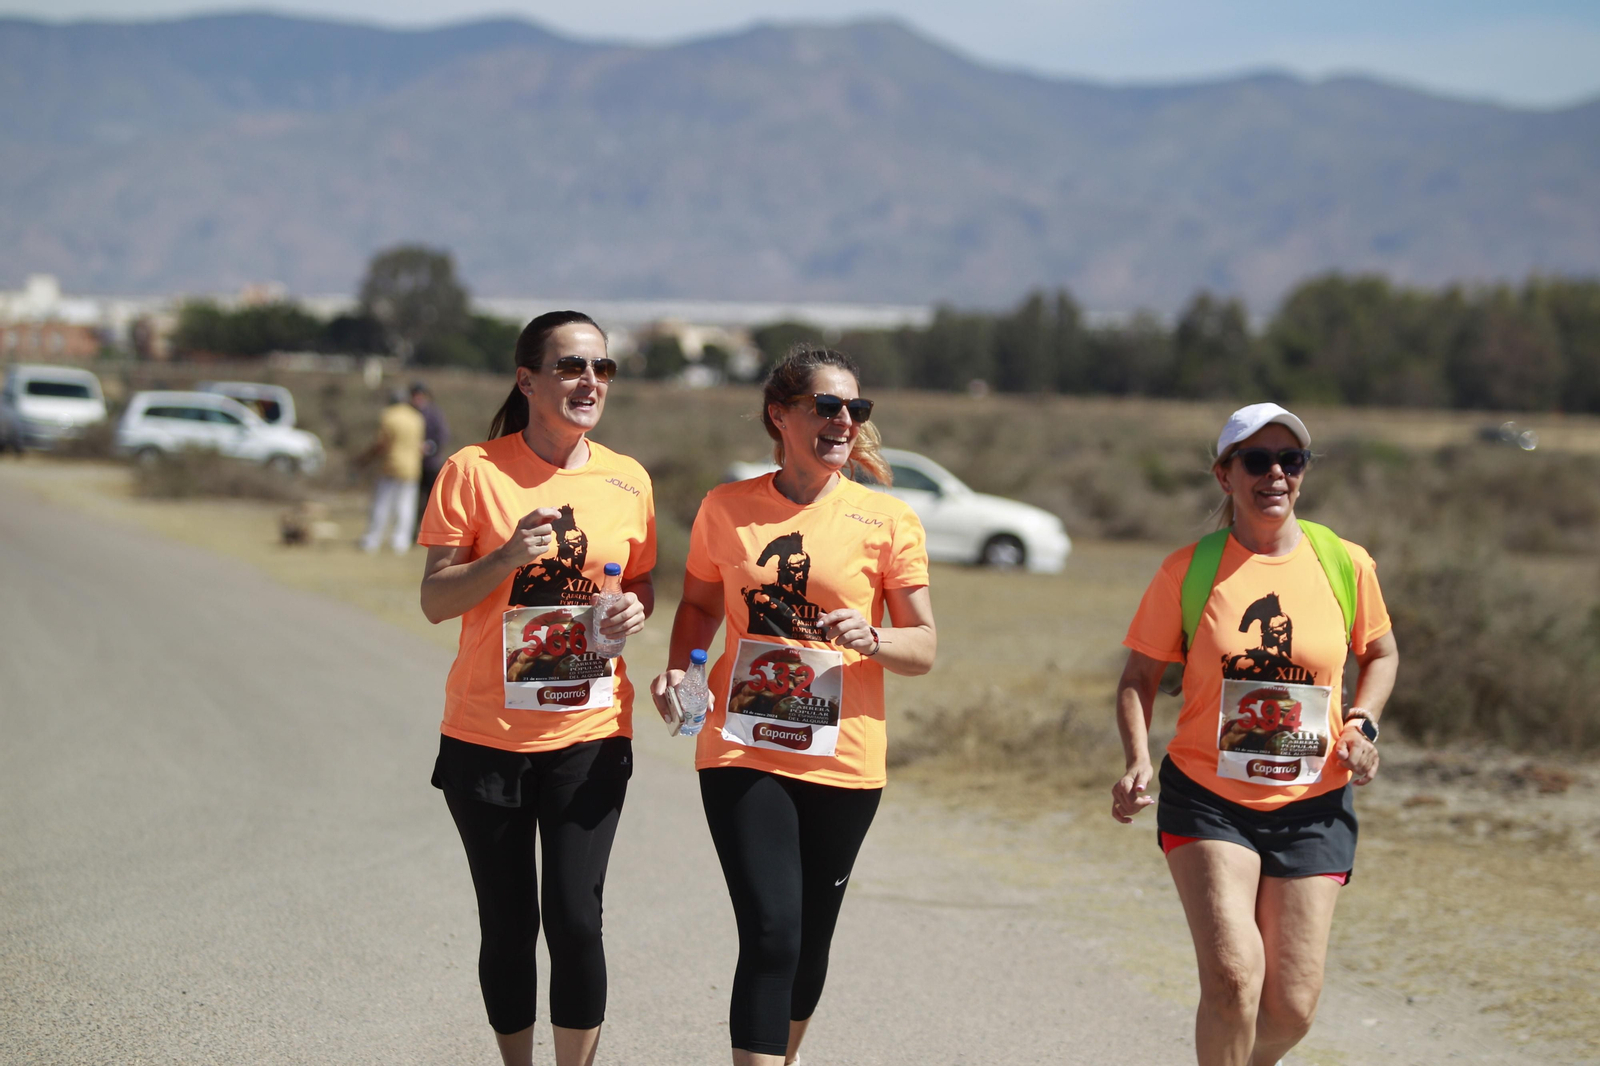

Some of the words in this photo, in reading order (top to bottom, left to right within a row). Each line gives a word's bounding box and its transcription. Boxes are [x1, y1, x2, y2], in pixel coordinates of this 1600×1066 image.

[605, 477, 640, 497] JOLUVI
[844, 513, 884, 528] JOLUVI
[563, 577, 594, 593] XIII
[791, 618, 819, 627] CARRER
[792, 626, 822, 635] POPULAR
[522, 622, 587, 657] 566
[569, 660, 603, 668] CARRERA
[747, 659, 816, 698] 532
[1275, 666, 1308, 681] XIII
[790, 696, 830, 708] XIII
[790, 704, 830, 713] CARRERA
[789, 708, 829, 717] POPULAR
[1237, 697, 1302, 732] 594
[1282, 731, 1319, 741] XIII
